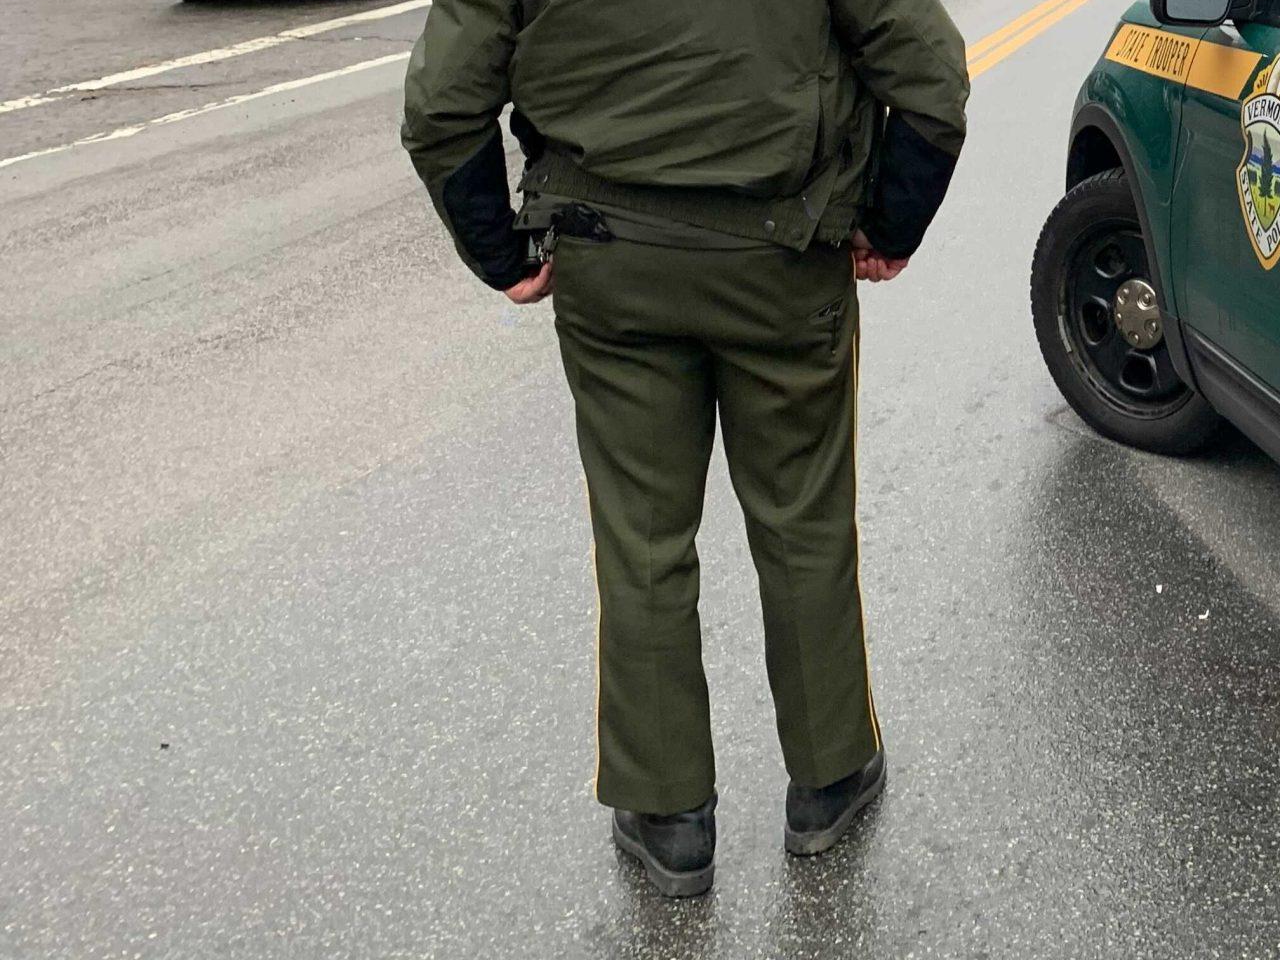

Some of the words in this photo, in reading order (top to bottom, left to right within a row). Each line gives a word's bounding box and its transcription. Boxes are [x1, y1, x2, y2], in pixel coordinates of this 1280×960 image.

[1116, 29, 1150, 63] STATE
[1145, 35, 1190, 77] TROOPER
[1241, 171, 1263, 245] STATE
